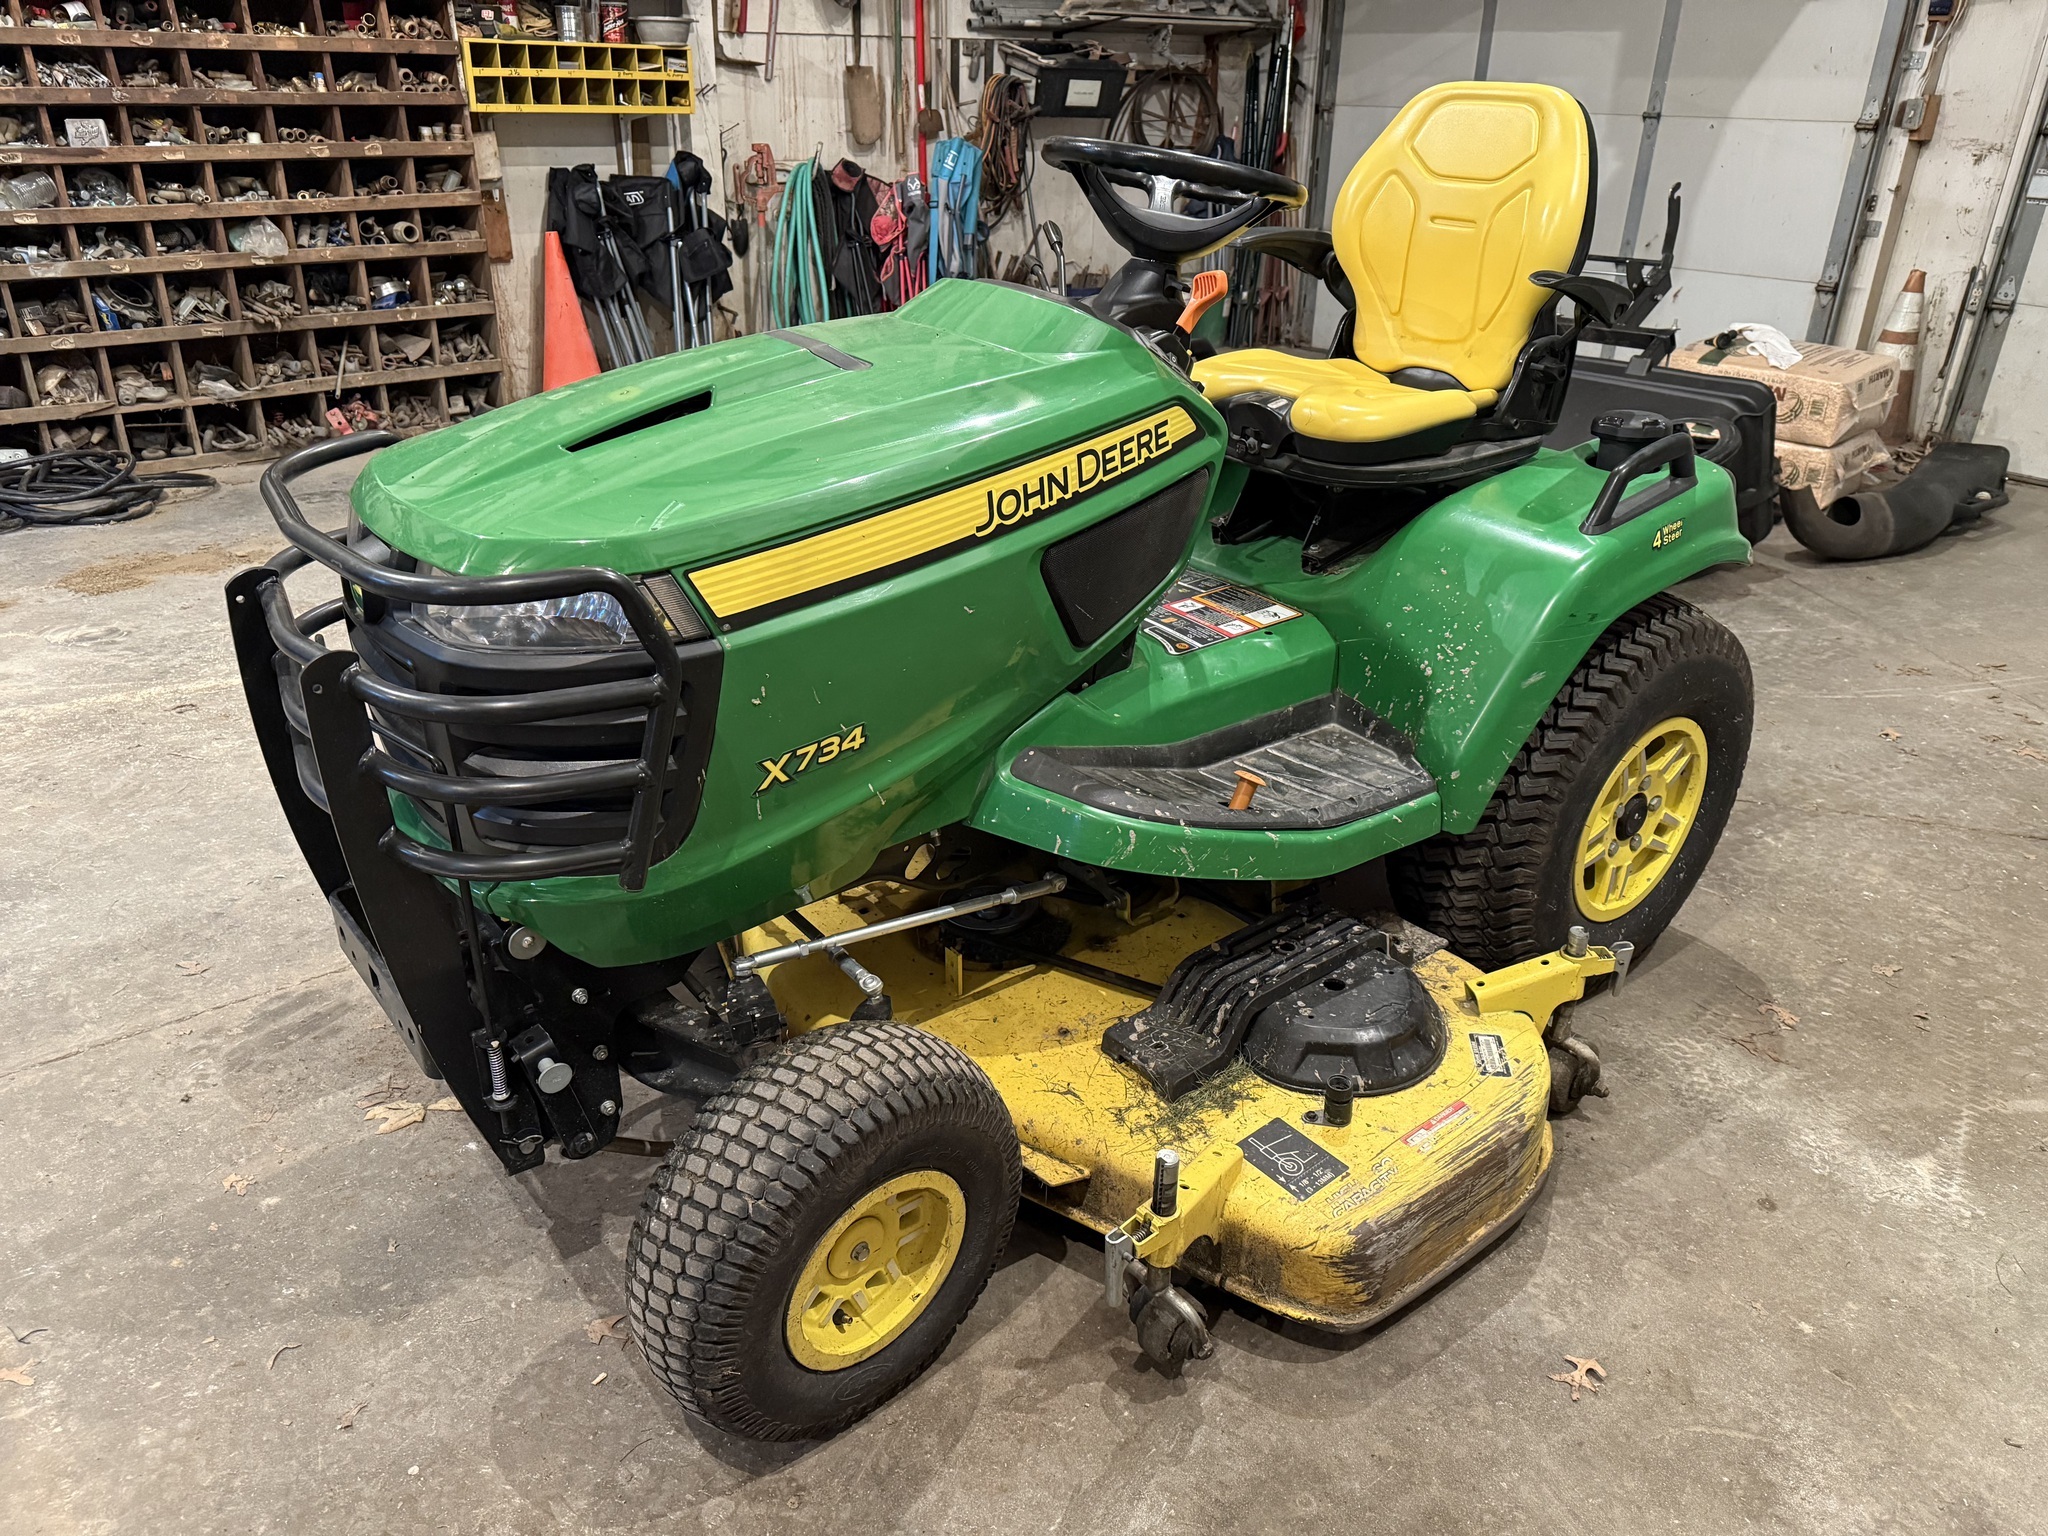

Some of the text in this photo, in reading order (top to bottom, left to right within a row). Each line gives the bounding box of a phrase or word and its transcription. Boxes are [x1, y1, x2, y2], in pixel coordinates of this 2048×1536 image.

[975, 418, 1171, 534] JOHN DEERE
[1653, 529, 1662, 549] 4
[1662, 520, 1683, 536] Wheel
[1663, 529, 1683, 545] Steer
[757, 725, 866, 792] X734
[1332, 1166, 1399, 1218] CAPACITY
